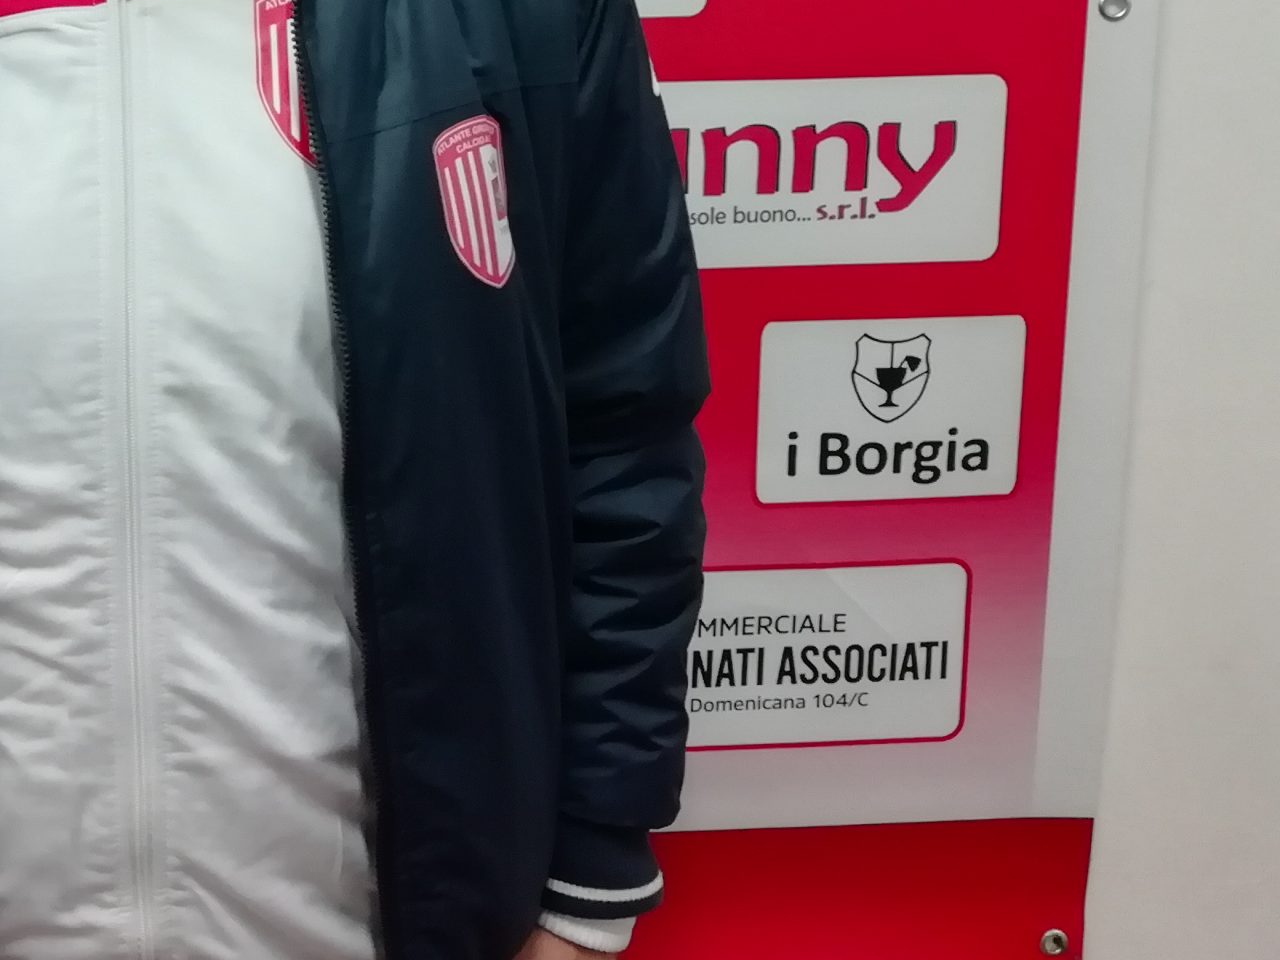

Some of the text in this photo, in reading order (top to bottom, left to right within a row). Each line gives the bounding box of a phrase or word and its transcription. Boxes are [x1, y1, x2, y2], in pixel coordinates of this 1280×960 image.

[689, 207, 726, 225] sole
[733, 206, 811, 224] buono...
[787, 427, 989, 484] i Borgia
[698, 613, 847, 638] MMERCIALE
[691, 641, 949, 688] NATI ASSOCIATI
[690, 692, 869, 713] Domenicana 104/C
